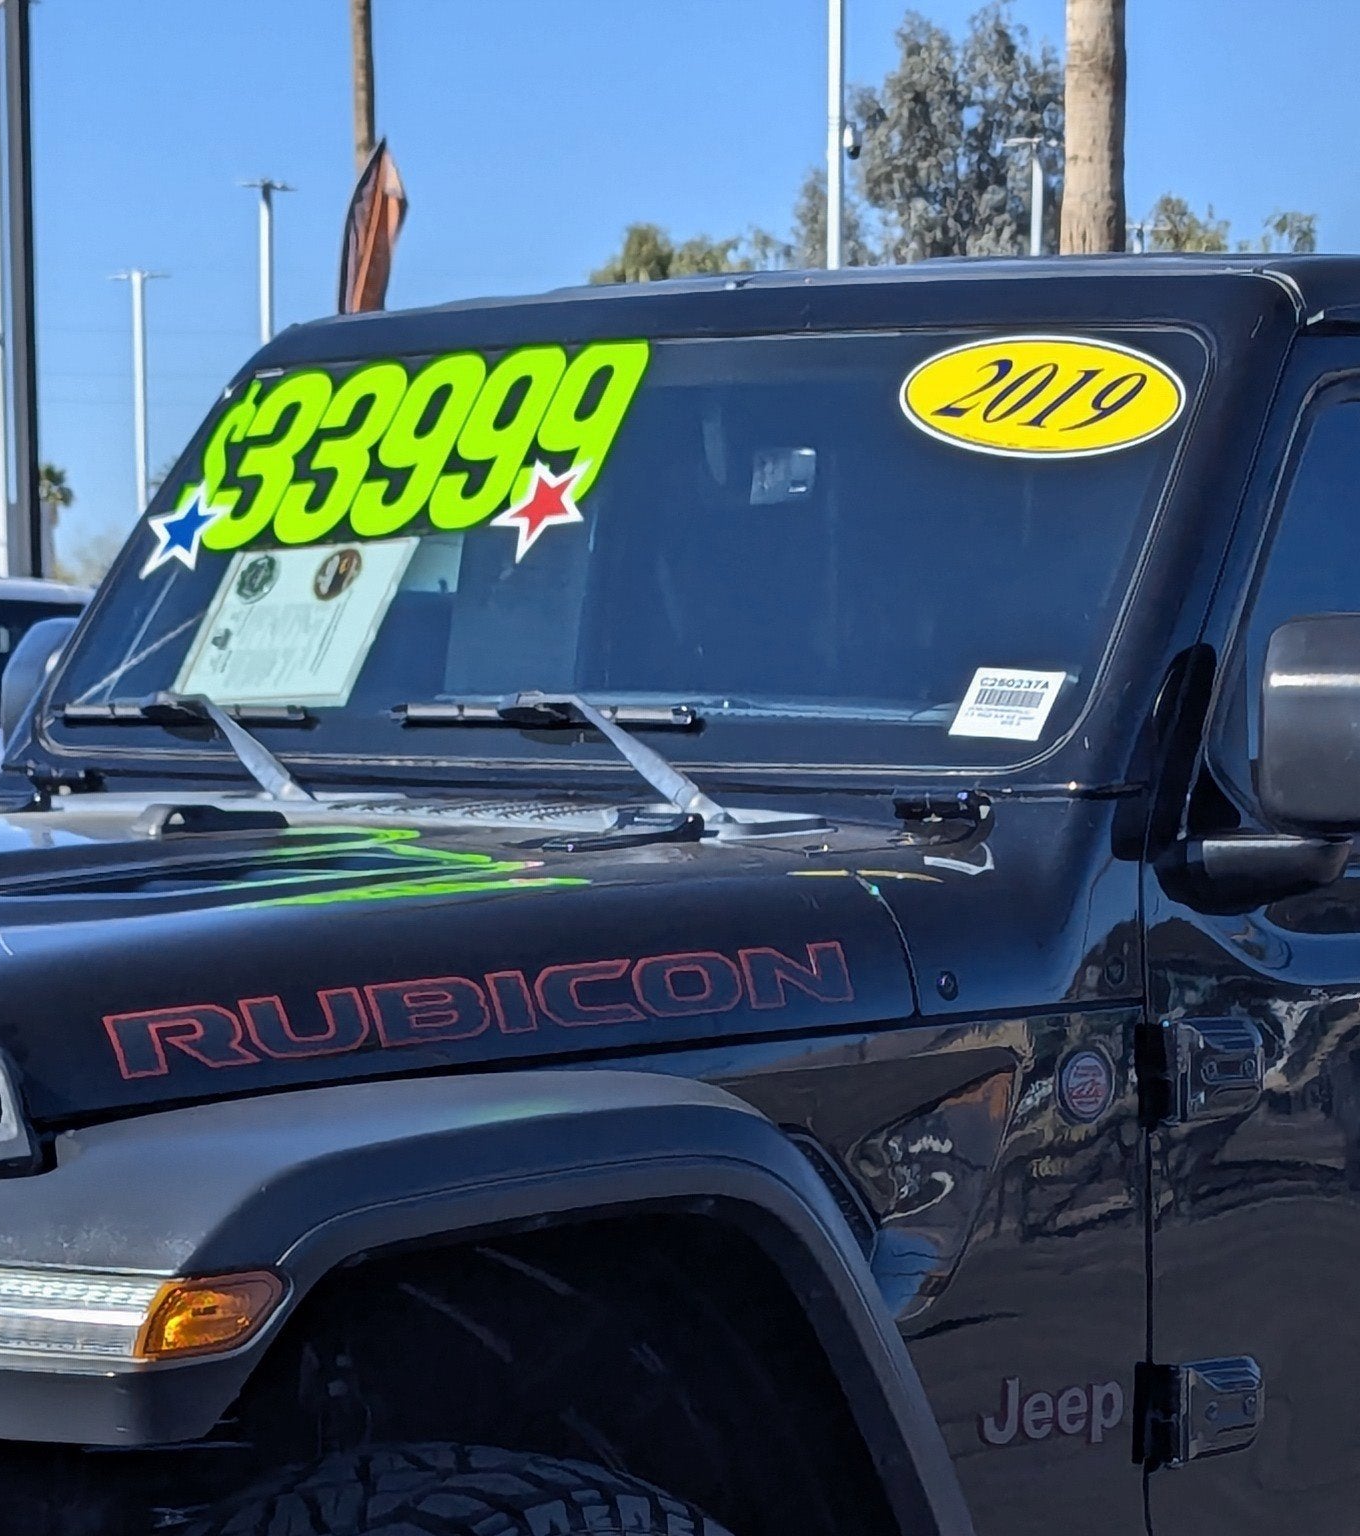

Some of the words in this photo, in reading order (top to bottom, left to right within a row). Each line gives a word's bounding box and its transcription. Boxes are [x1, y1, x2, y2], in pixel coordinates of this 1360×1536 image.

[176, 338, 650, 552] $33999
[930, 358, 1149, 432] 2019
[103, 941, 854, 1080] RUBICON
[978, 1374, 1124, 1446] Jeep
